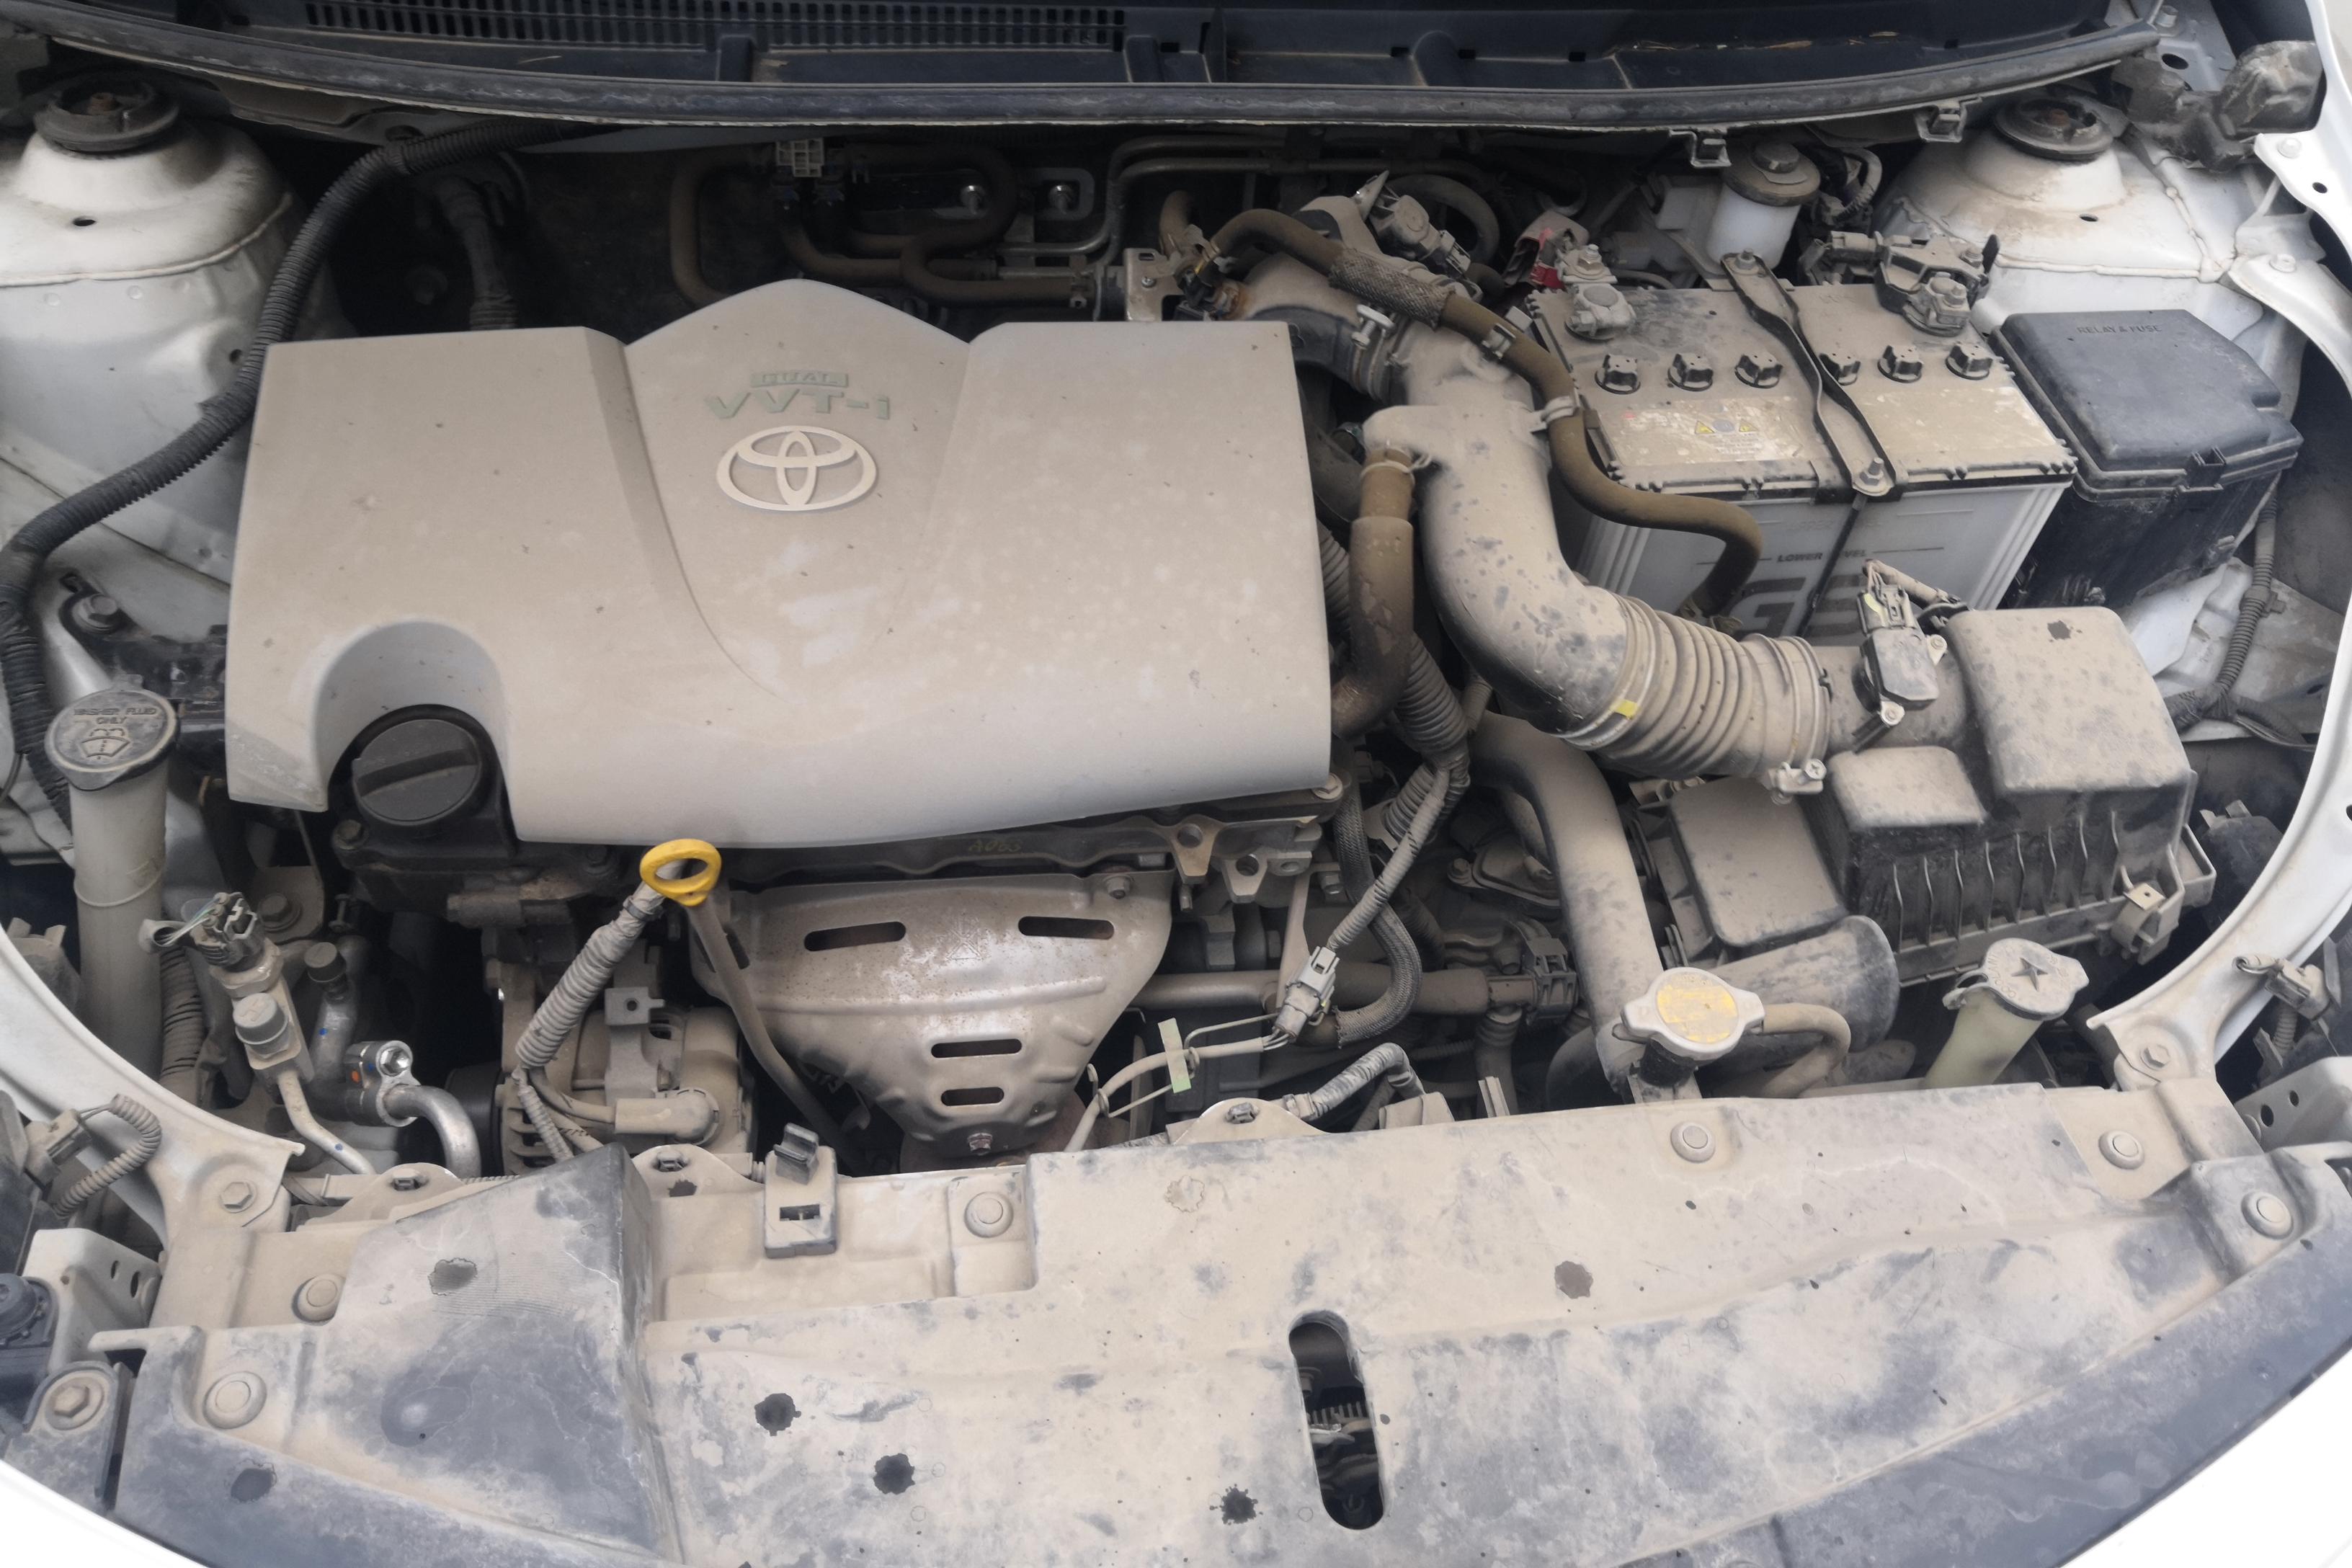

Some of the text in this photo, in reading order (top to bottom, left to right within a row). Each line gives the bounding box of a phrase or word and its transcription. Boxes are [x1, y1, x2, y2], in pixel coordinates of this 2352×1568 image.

[2129, 324, 2162, 333] FUSE
[760, 371, 839, 385] DUAL
[1777, 552, 1823, 562] LOWER
[96, 716, 128, 725] ONLY
